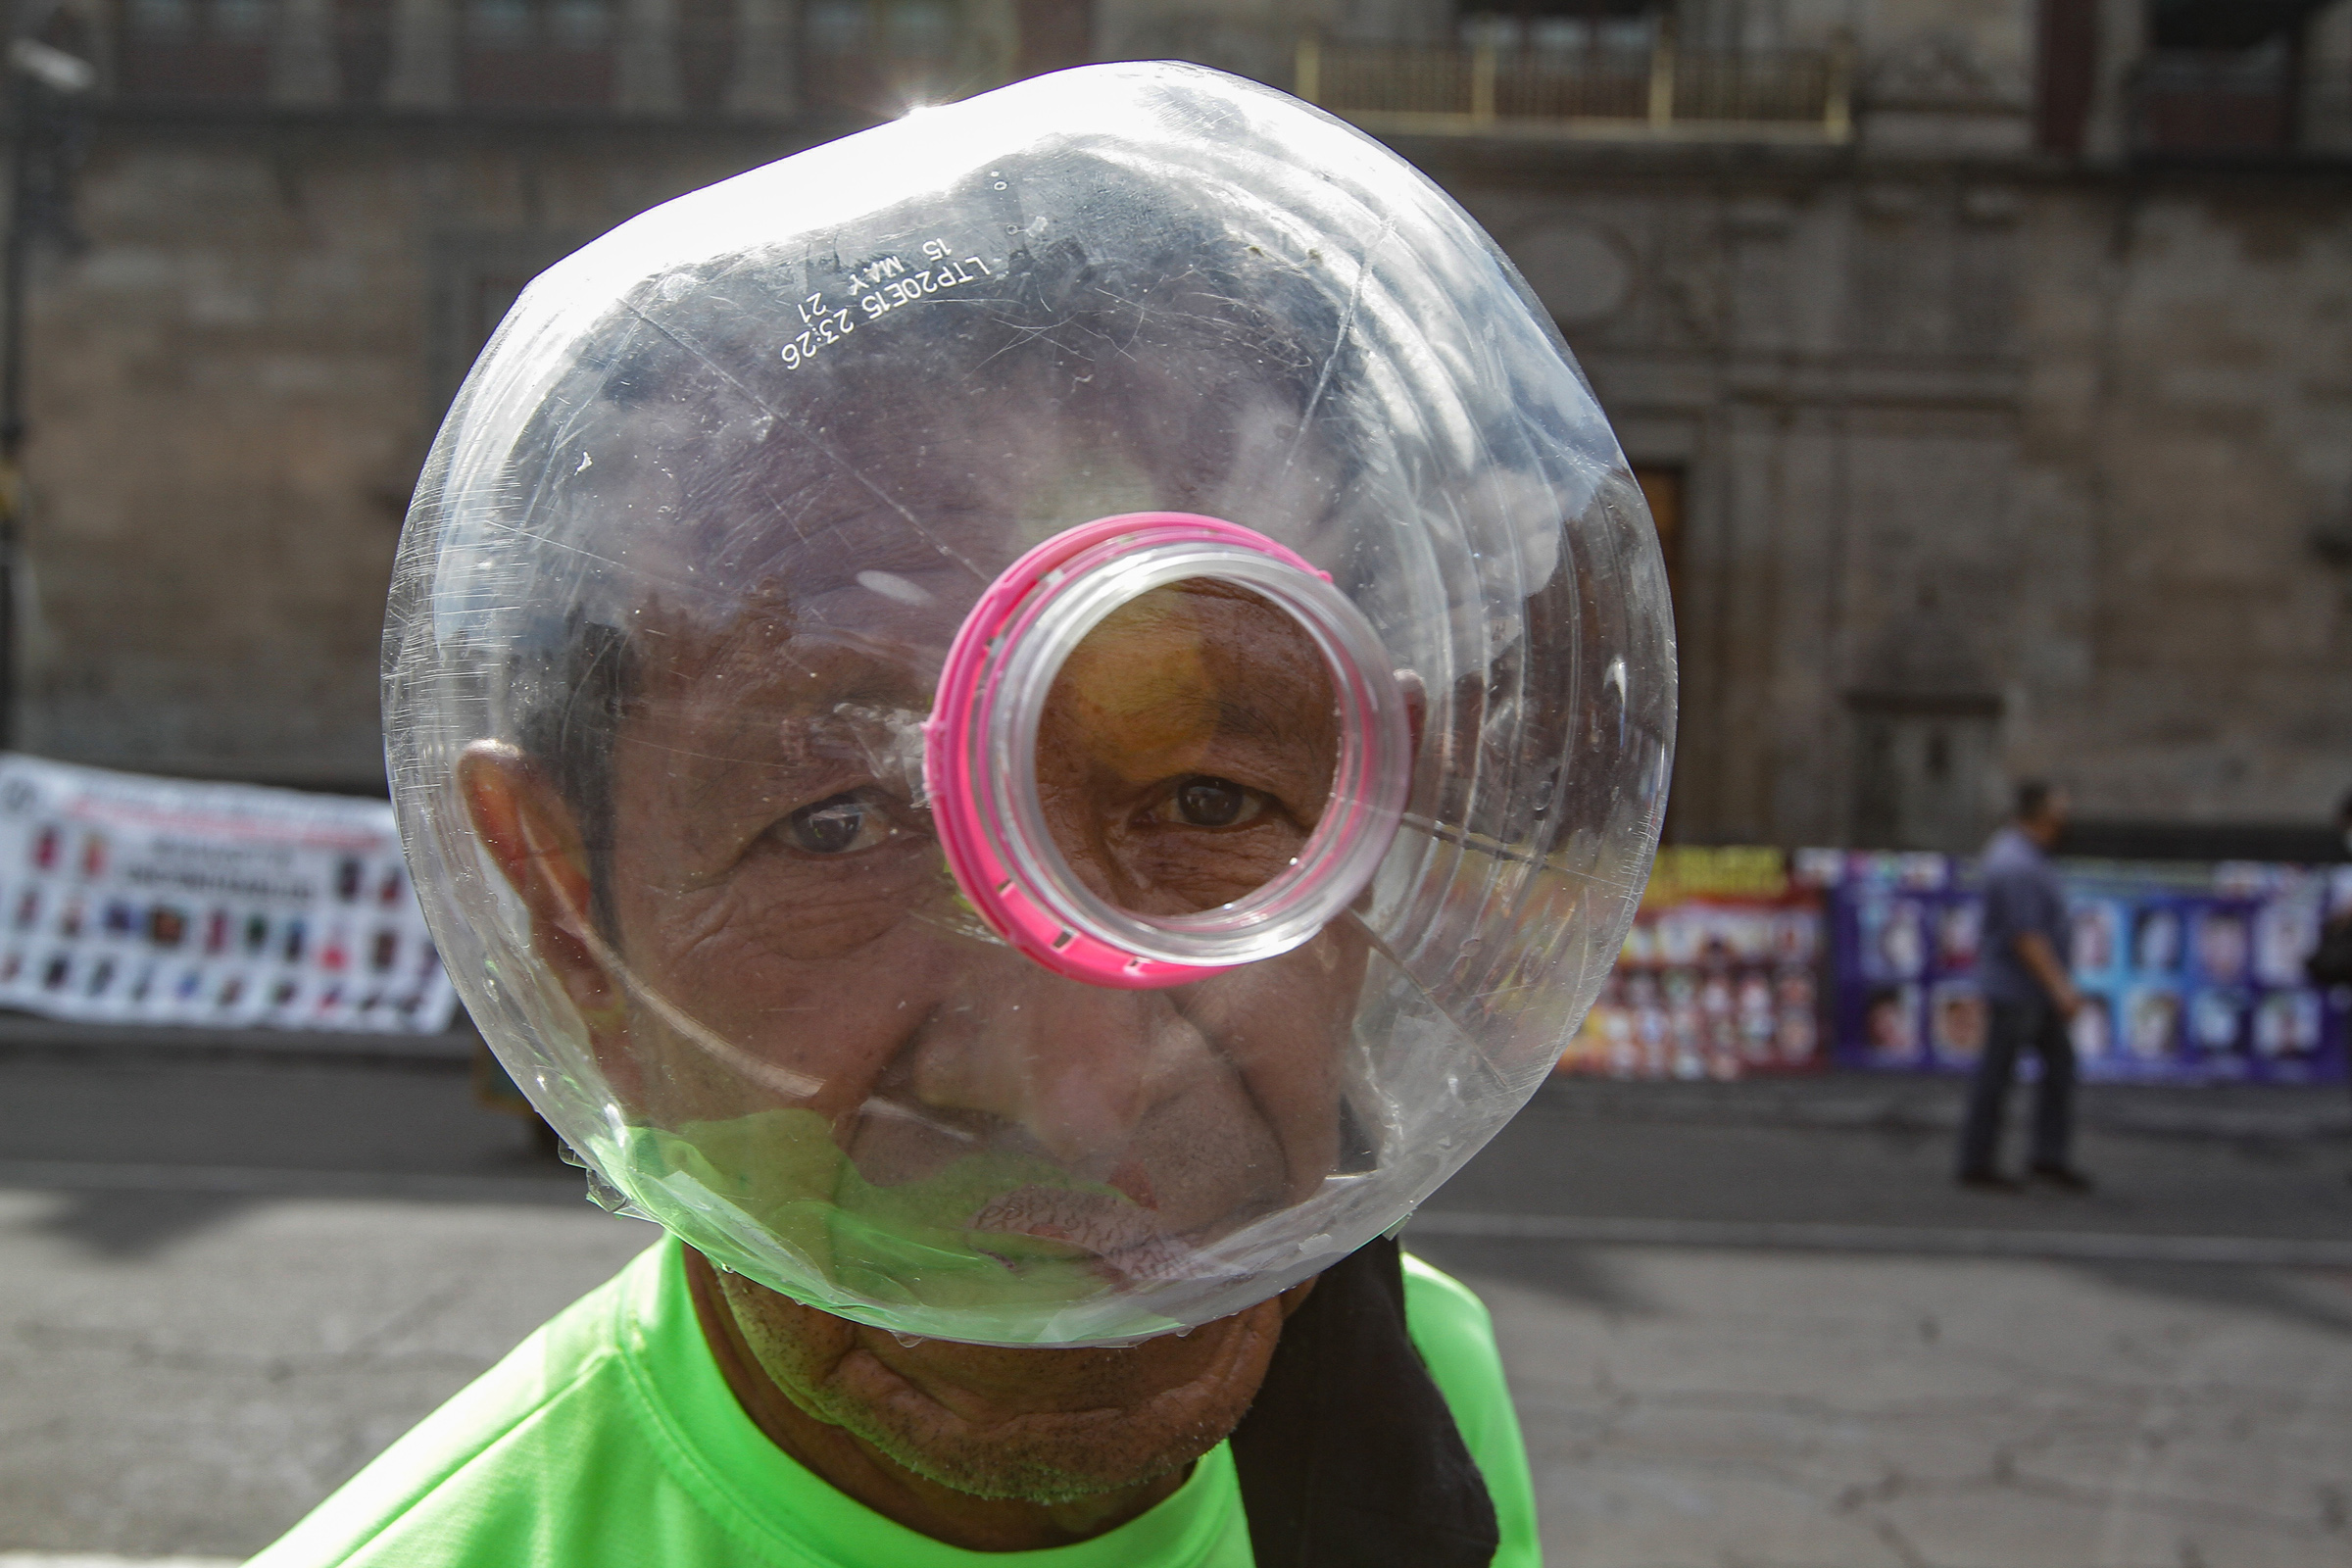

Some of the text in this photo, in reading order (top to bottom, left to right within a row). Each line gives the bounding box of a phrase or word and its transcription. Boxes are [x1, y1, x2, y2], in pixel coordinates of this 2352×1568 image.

[781, 256, 991, 369] LTP20E15 23:26
[798, 238, 951, 323] 15 MAY 21
